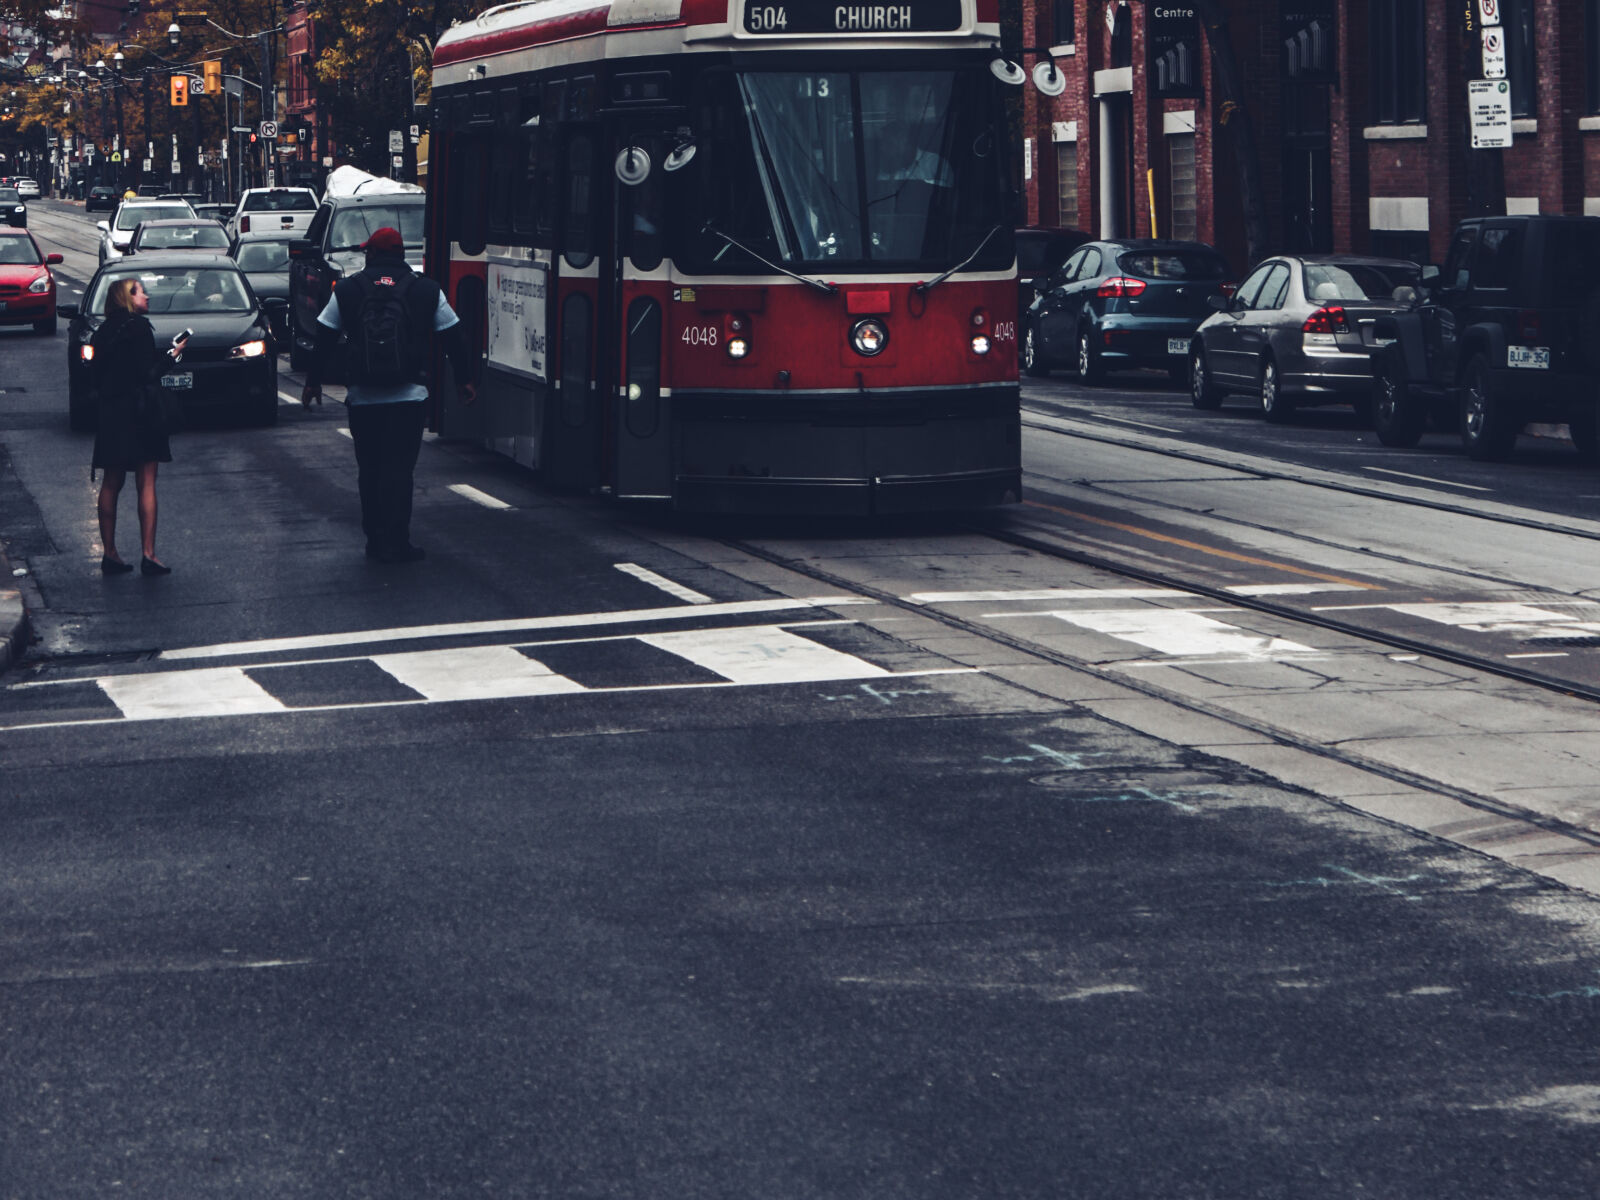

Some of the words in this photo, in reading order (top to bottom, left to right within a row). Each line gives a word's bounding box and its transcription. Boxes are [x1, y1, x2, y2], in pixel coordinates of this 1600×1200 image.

[750, 6, 788, 30] 504
[834, 5, 911, 30] CHURCH
[1154, 6, 1194, 19] Centre
[681, 326, 718, 346] 4048
[994, 321, 1015, 342] 4048
